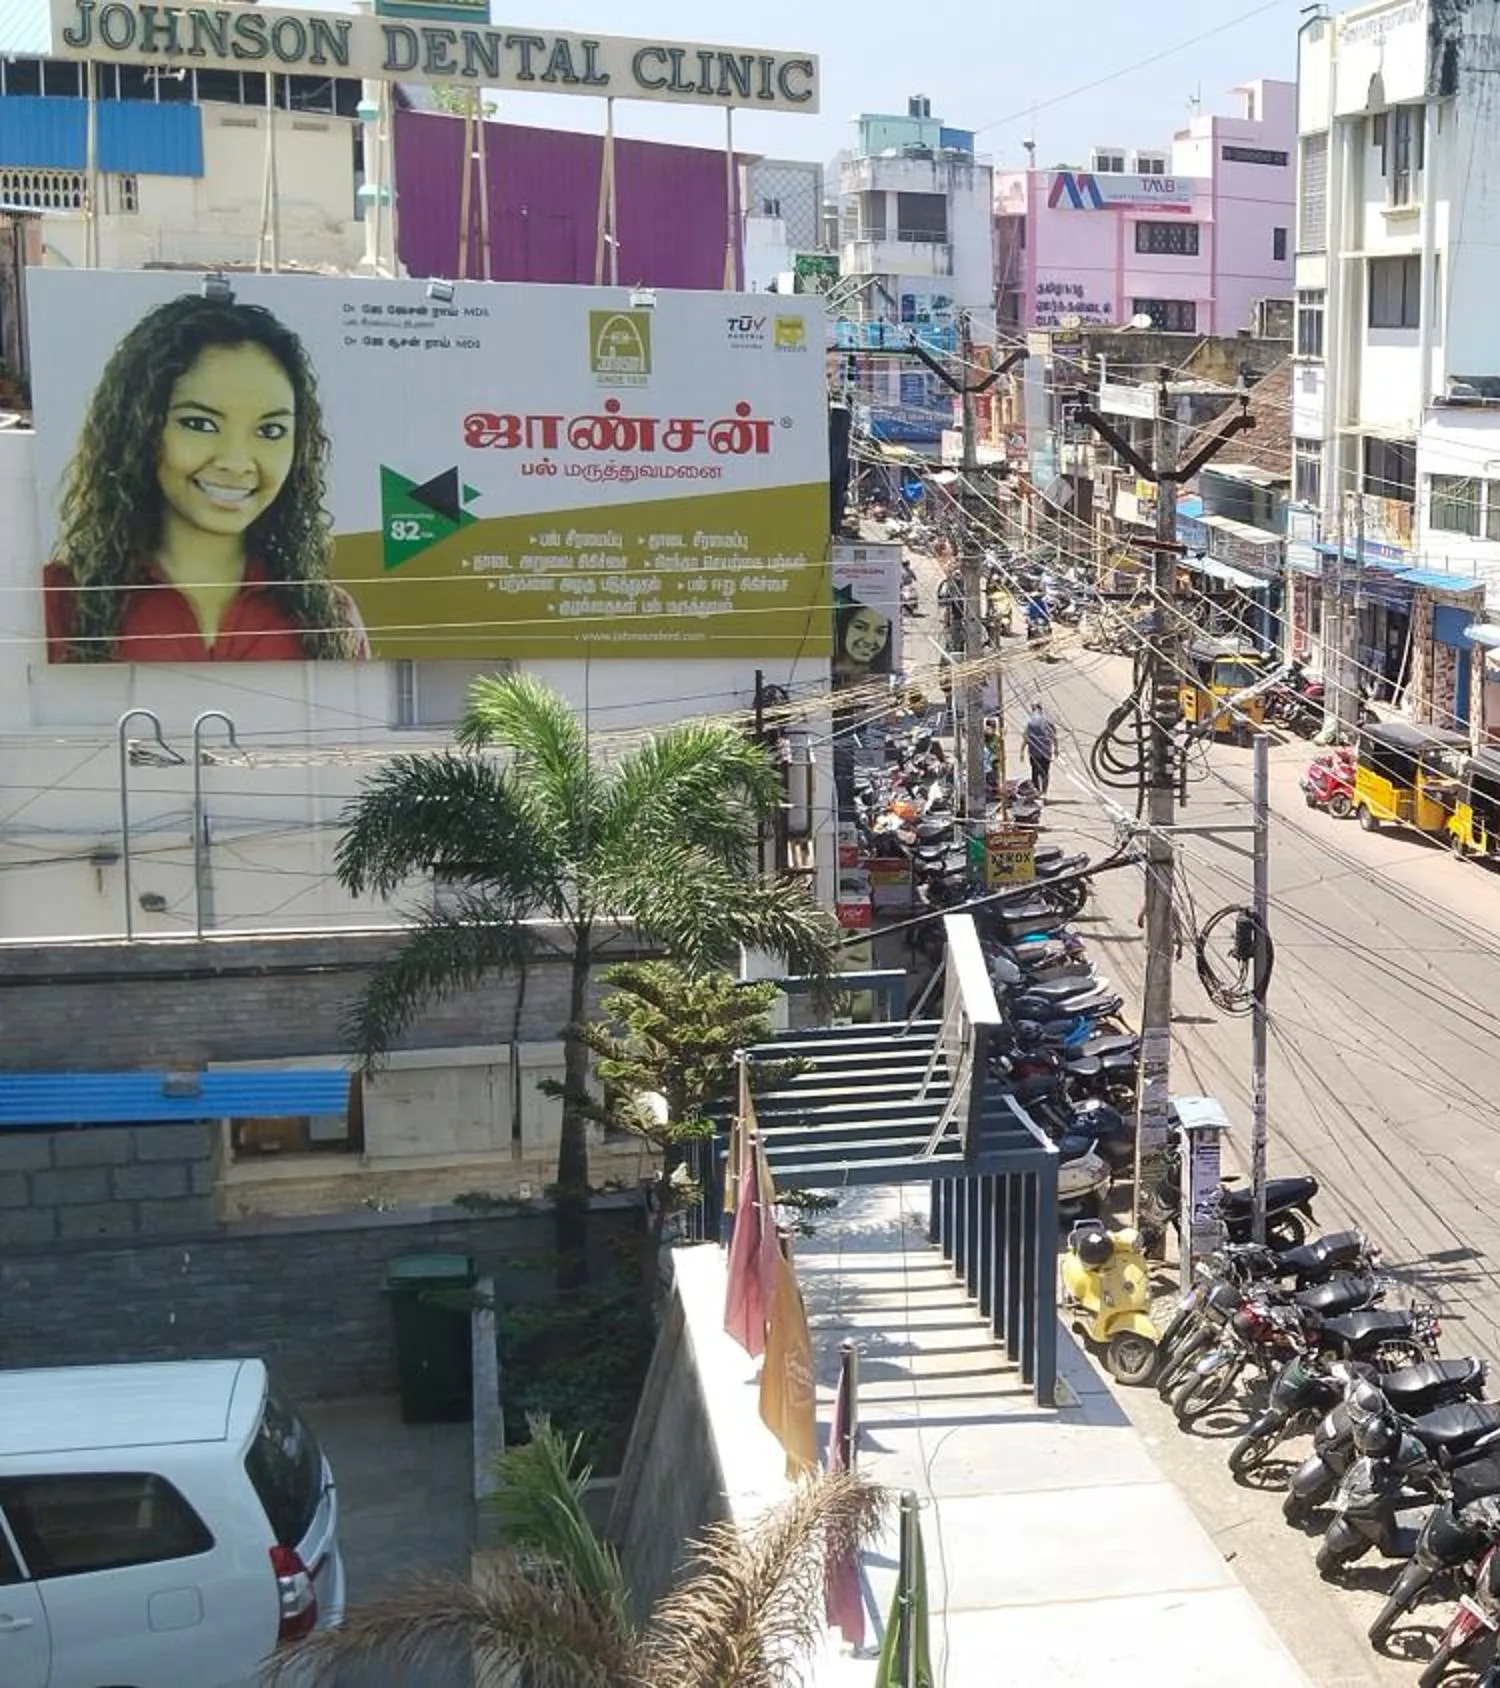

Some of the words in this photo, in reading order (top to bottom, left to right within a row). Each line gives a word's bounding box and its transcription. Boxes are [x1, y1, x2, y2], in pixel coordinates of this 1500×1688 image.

[63, 0, 352, 66] JOHNSON
[382, 23, 611, 87] DENTAL
[631, 46, 815, 102] CLINIC
[463, 398, 775, 455] ஜாண்சன்
[520, 457, 558, 477] பல்
[563, 460, 723, 482] மருத்துவமனை
[391, 520, 420, 540] 82
